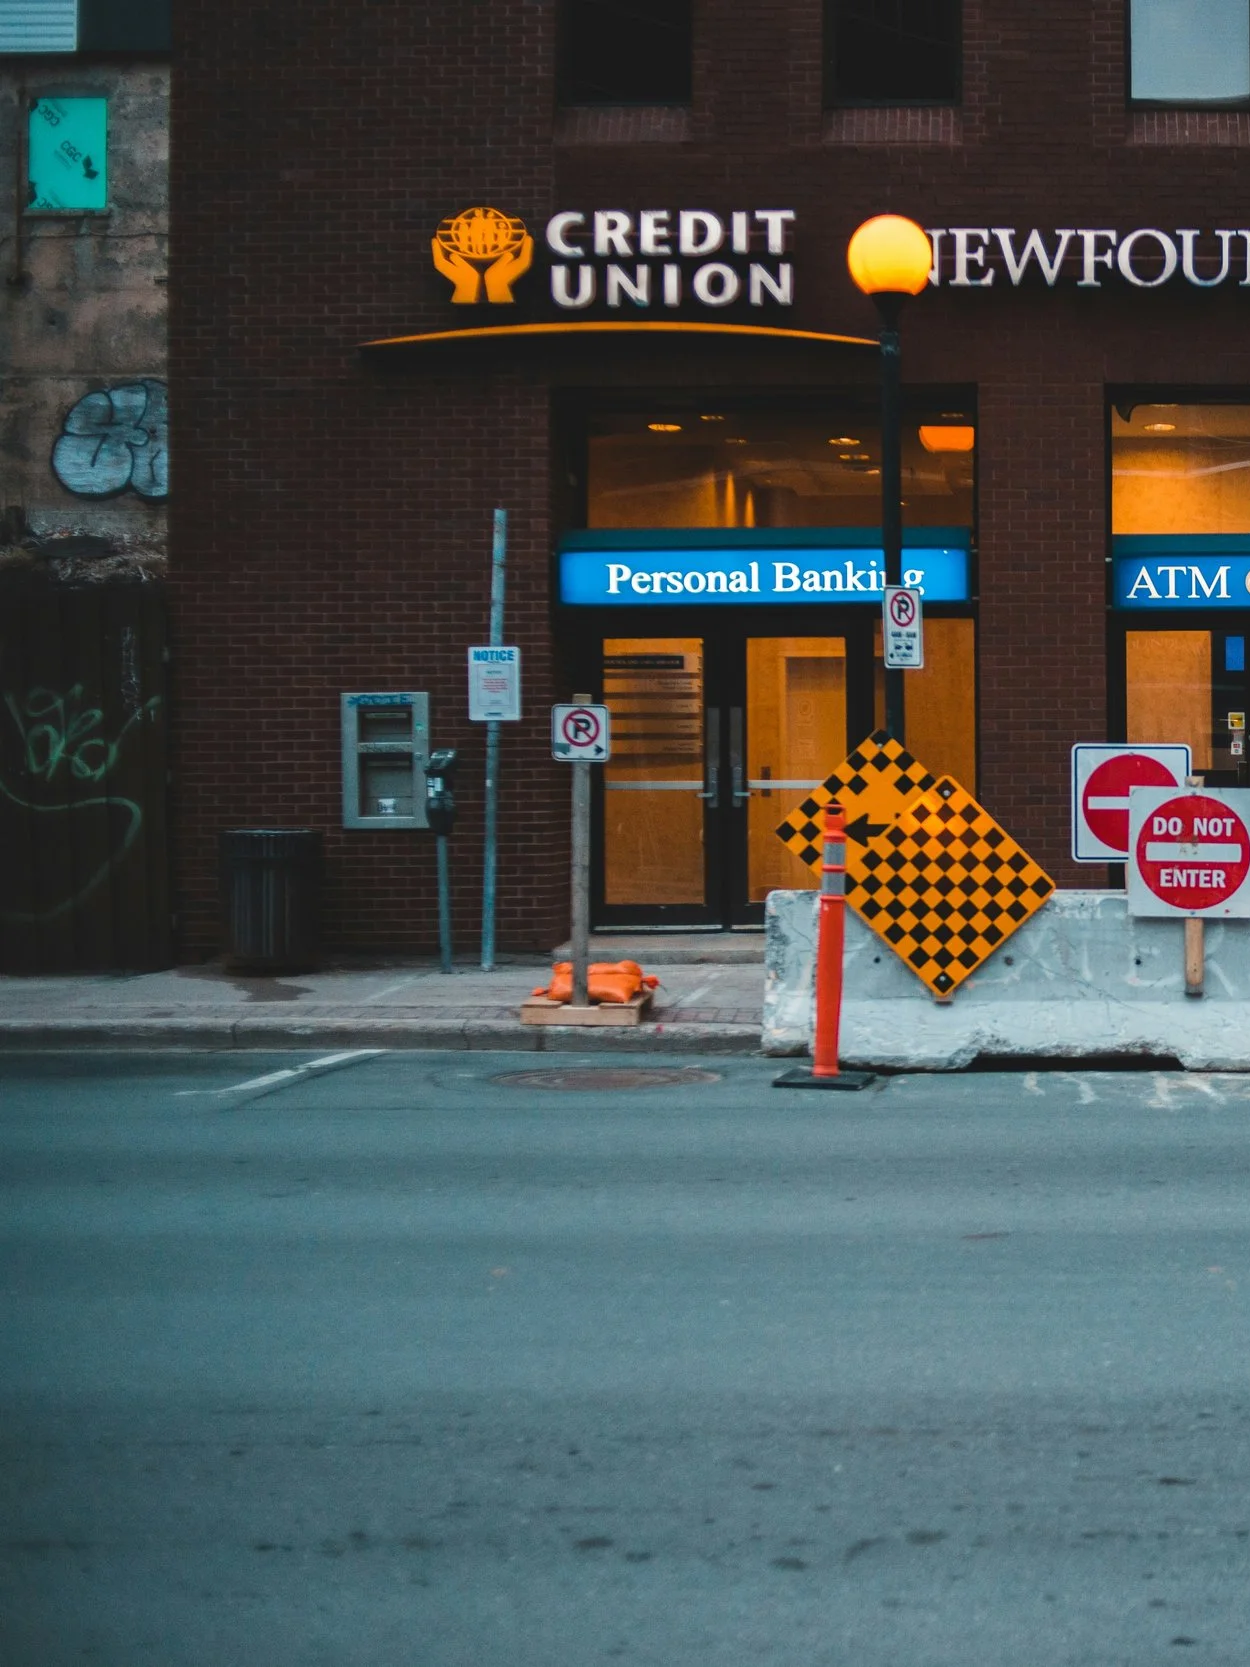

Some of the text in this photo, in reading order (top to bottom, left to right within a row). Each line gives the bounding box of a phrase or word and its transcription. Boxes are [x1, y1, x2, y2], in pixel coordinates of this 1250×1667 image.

[60, 140, 82, 162] CGC
[546, 210, 795, 256] CREDIT
[551, 263, 793, 307] UNION
[606, 560, 925, 596] Personal Bankig
[1126, 566, 1232, 599] ATM
[473, 650, 515, 662] NOTICE
[1153, 816, 1236, 836] DO NOT
[1159, 868, 1227, 888] ENTER
